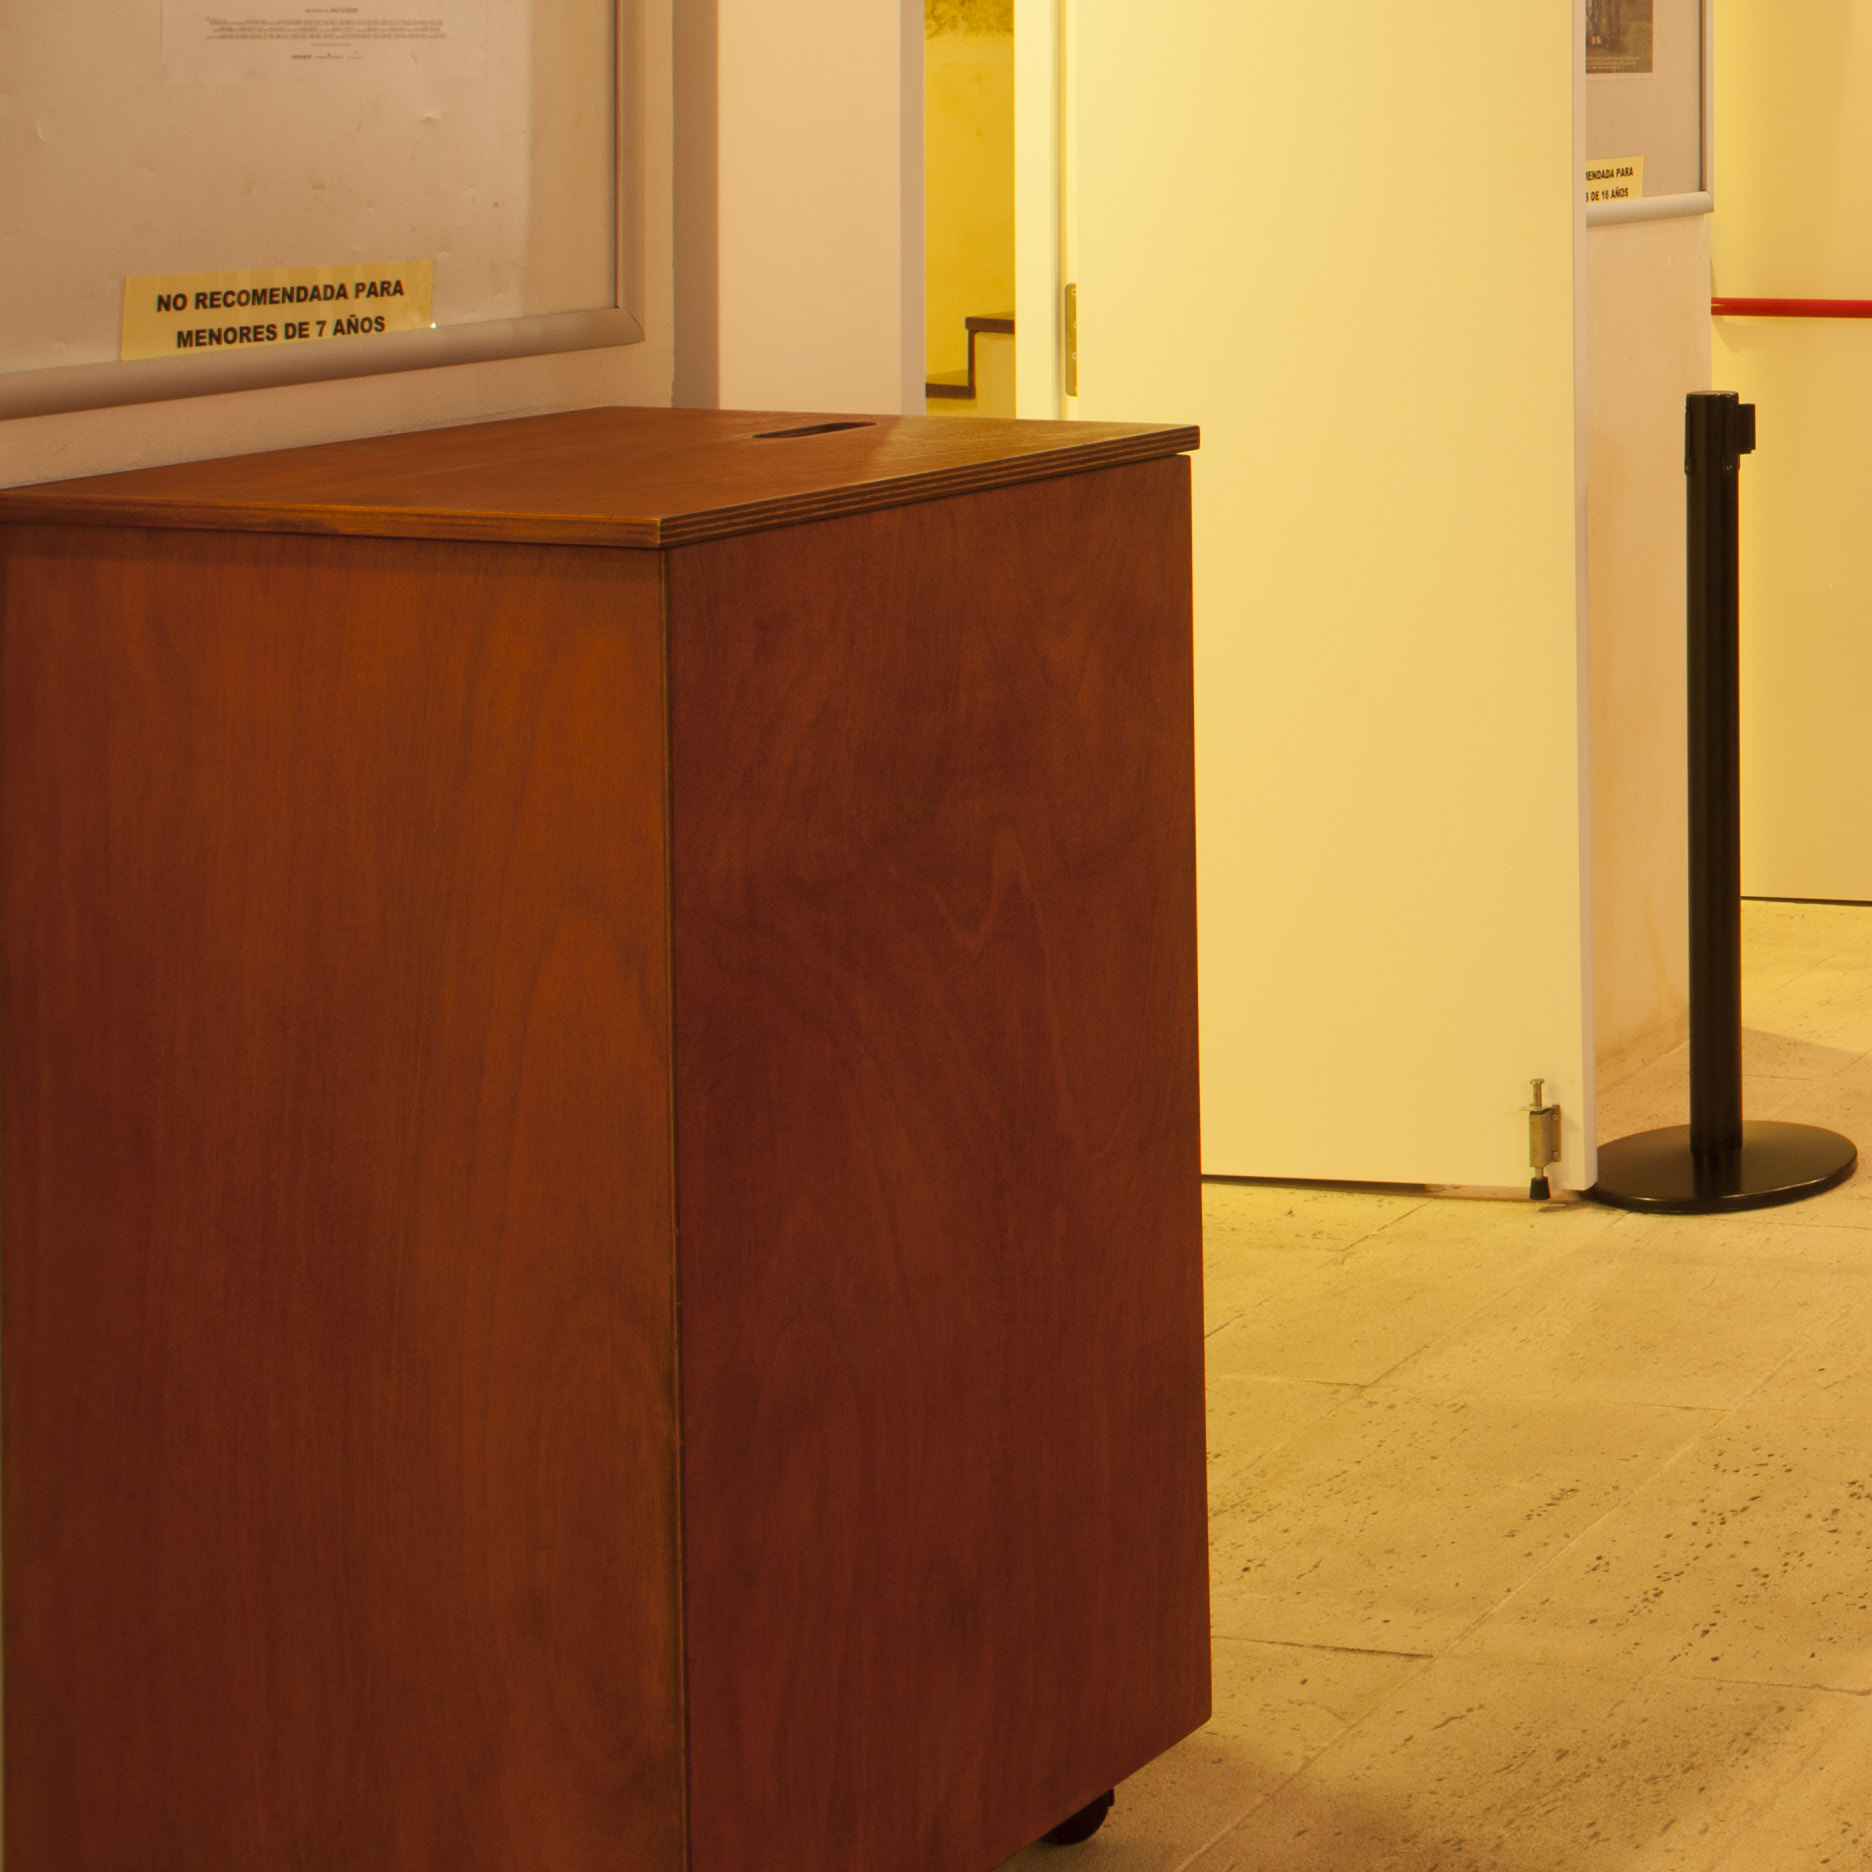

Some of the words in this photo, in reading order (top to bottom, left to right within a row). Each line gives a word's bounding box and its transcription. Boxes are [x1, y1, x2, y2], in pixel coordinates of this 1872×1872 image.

[1586, 169, 1614, 181] ENDADA
[1616, 166, 1633, 178] PARA
[1591, 191, 1599, 202] DE
[1611, 186, 1629, 199] AÑOS
[157, 293, 188, 312] NO
[195, 283, 348, 310] RECOMENDADA
[355, 280, 404, 299] PARA
[177, 324, 277, 348] MENORES
[284, 322, 310, 339] DE
[316, 320, 327, 337] 7
[332, 315, 385, 336] AÑOS
